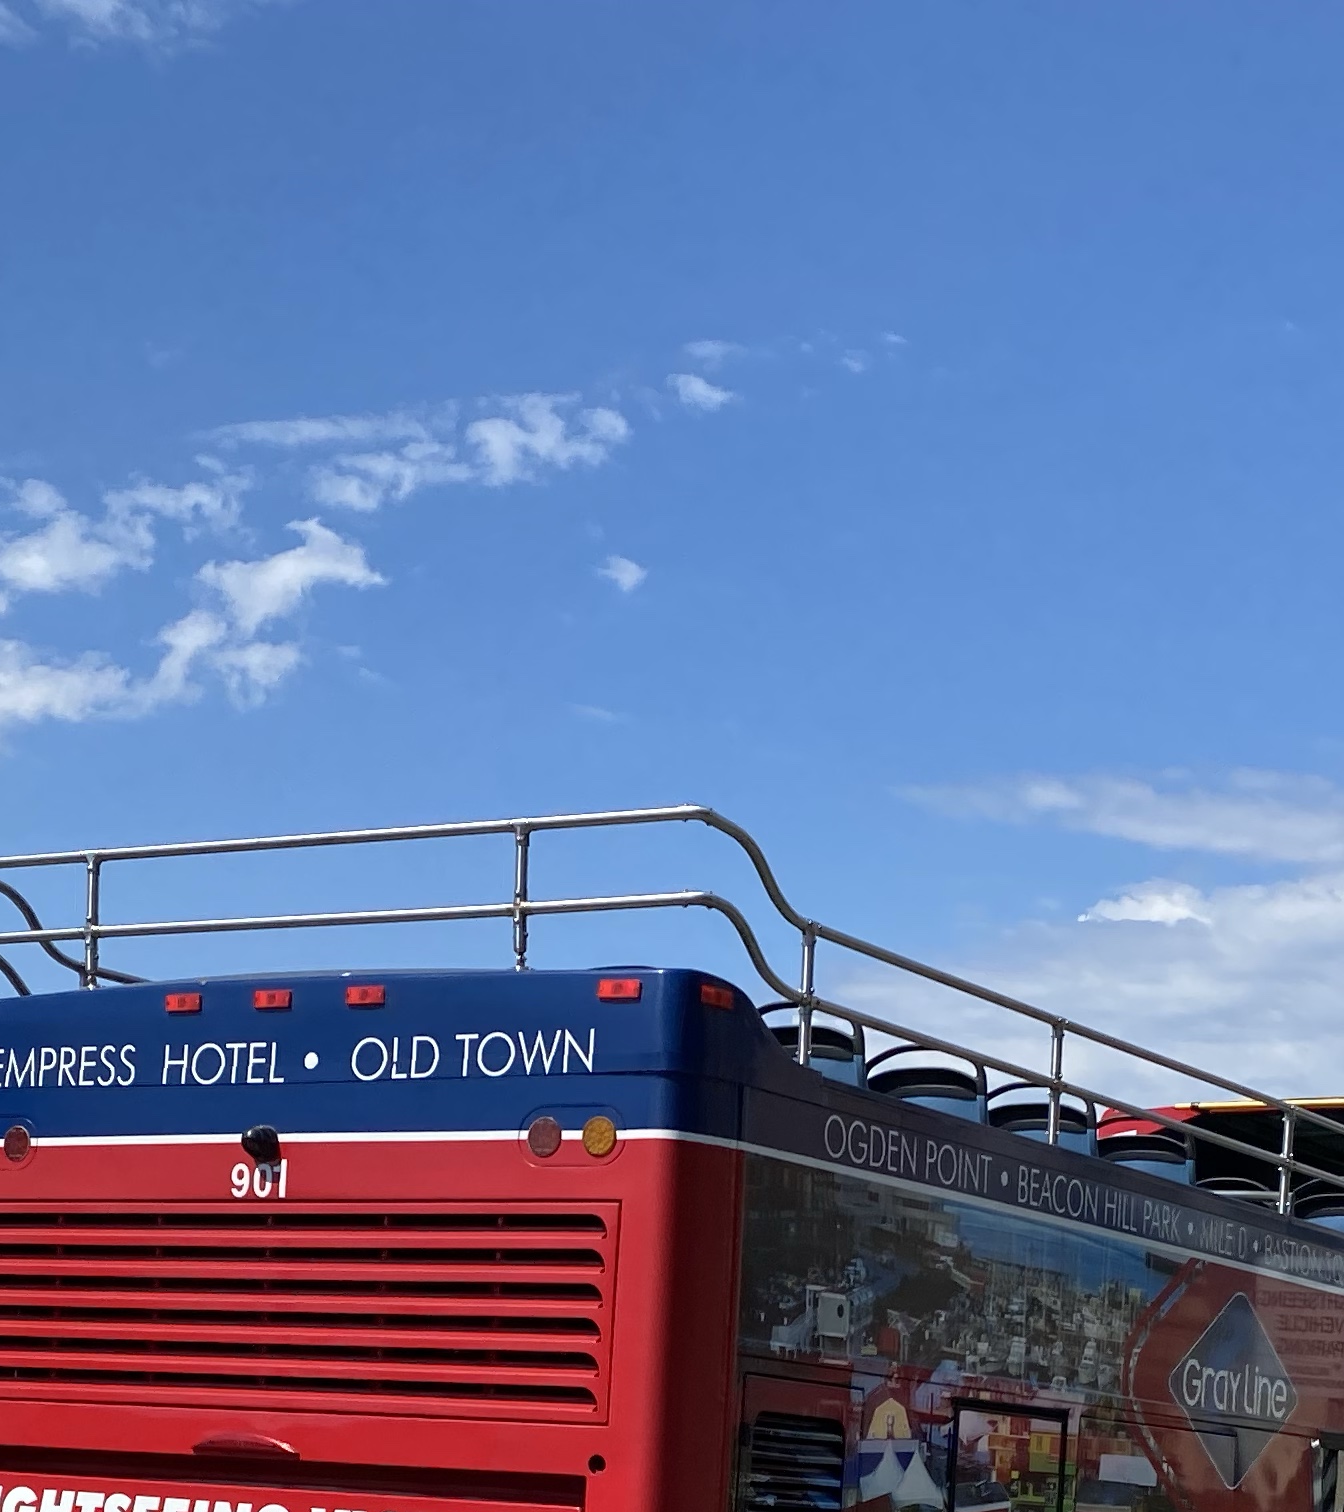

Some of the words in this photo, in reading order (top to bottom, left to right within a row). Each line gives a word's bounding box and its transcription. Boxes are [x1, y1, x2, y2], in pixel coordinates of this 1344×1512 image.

[160, 1041, 286, 1086] HOTEL
[351, 1036, 440, 1081] OLD
[455, 1028, 596, 1078] TOWN
[230, 1158, 288, 1198] 901
[825, 1114, 918, 1175] OGDEN
[925, 1139, 993, 1194] POINT
[1017, 1165, 1099, 1221] BEACON
[1104, 1188, 1137, 1232] HILL
[1142, 1200, 1182, 1243] PARK
[1264, 1234, 1320, 1278] BASTION
[1182, 1359, 1242, 1412] Gray
[1244, 1364, 1287, 1418] Line
